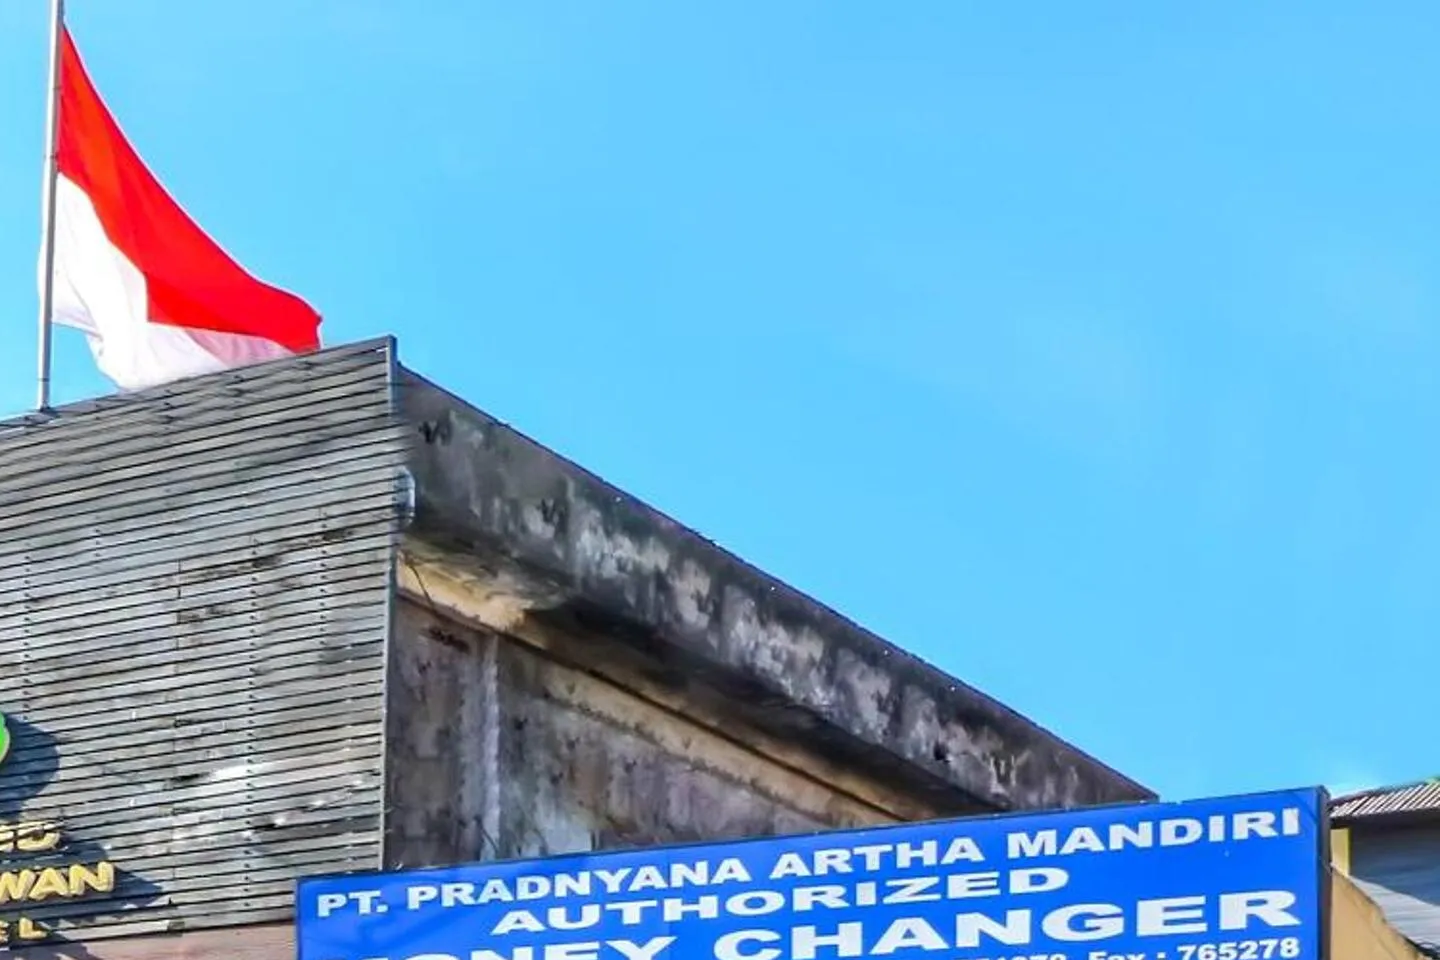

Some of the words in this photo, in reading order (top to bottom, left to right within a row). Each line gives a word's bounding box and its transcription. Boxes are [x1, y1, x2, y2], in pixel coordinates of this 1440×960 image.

[317, 890, 389, 917] PT.
[408, 858, 752, 910] PRADNYANA
[769, 837, 985, 879] ARTHA
[1007, 808, 1299, 859] MANDIRI
[491, 867, 1070, 935] AUTHORIZED
